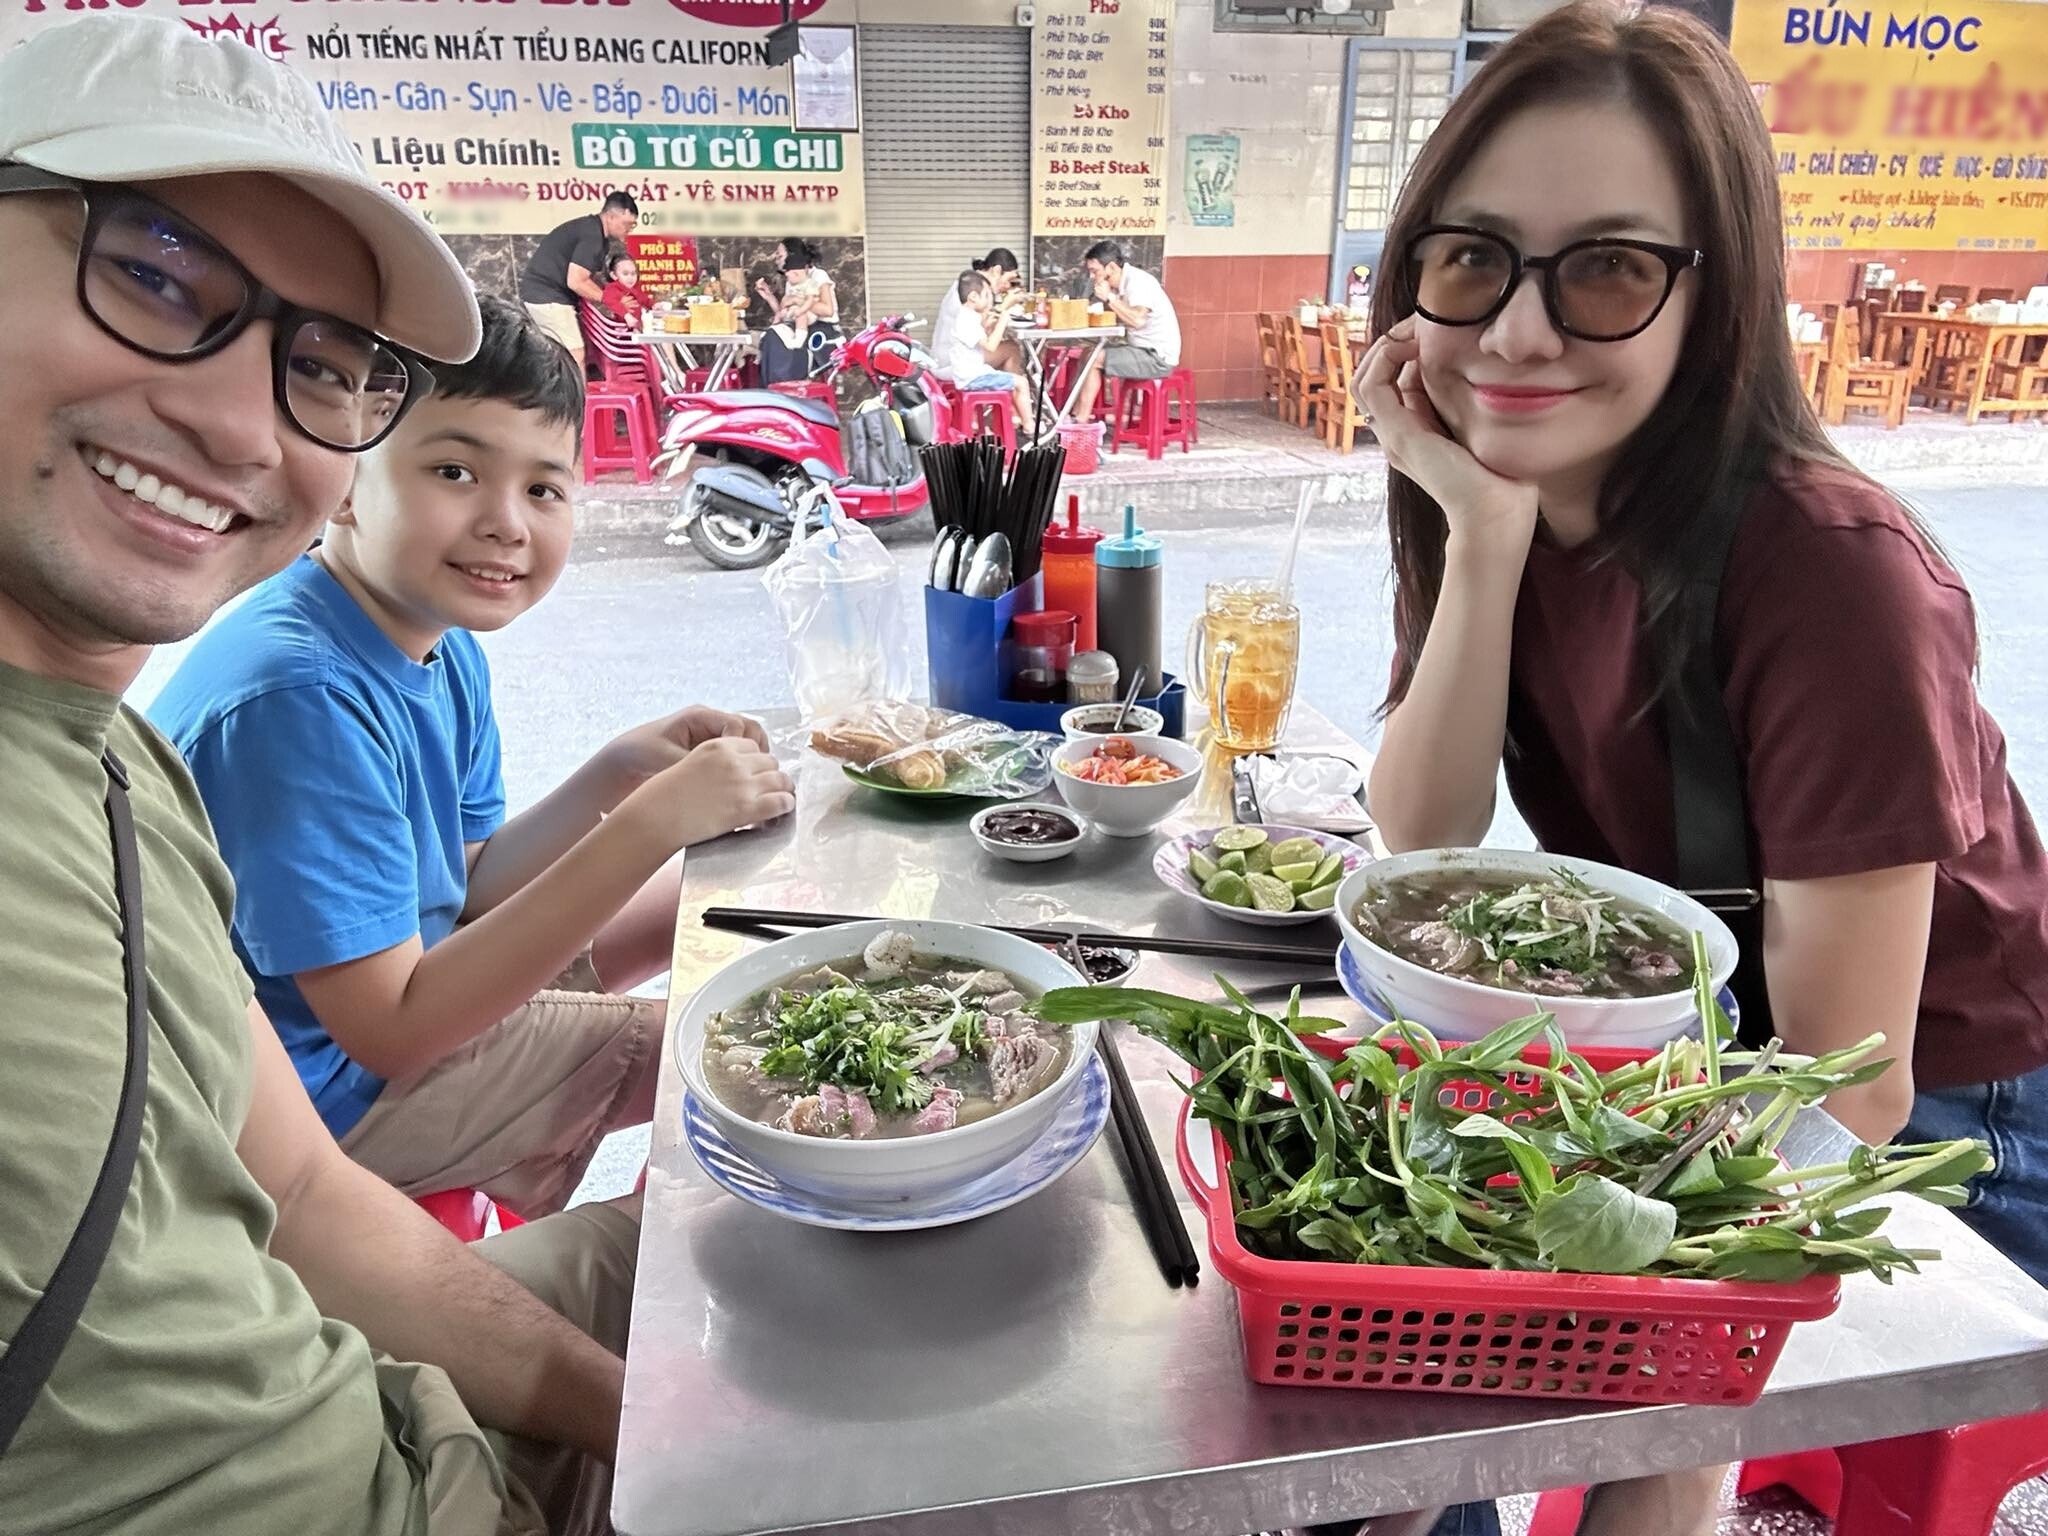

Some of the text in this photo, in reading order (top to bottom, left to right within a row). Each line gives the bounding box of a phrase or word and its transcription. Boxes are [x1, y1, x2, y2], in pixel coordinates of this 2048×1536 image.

[1090, 0, 1120, 13] Phở
[1784, 0, 1982, 61] BÚN MỌC
[307, 22, 350, 60] NỔI
[357, 25, 428, 60] TIẾNG
[434, 27, 505, 61] NHẤT
[514, 26, 567, 62] TIỂU
[575, 37, 644, 63] BANG
[652, 39, 770, 66] CALIFORN
[317, 80, 378, 111] Viên
[395, 81, 447, 111] Gân
[467, 82, 517, 117] Sụn
[538, 83, 573, 112] Vè
[594, 79, 642, 119] Bắp
[662, 84, 718, 115] Đuôi
[738, 86, 789, 116] Món
[1098, 105, 1129, 119] Kho
[372, 128, 838, 172] Liệu Chính: BÒ TƠ CỦ CHI
[1809, 146, 1835, 174] CHẢ
[1050, 160, 1150, 174] Bò Beef Steak
[625, 177, 668, 201] CÁT
[722, 183, 780, 202] SINH
[784, 184, 839, 202] ATTP
[639, 240, 665, 256] PHỞ
